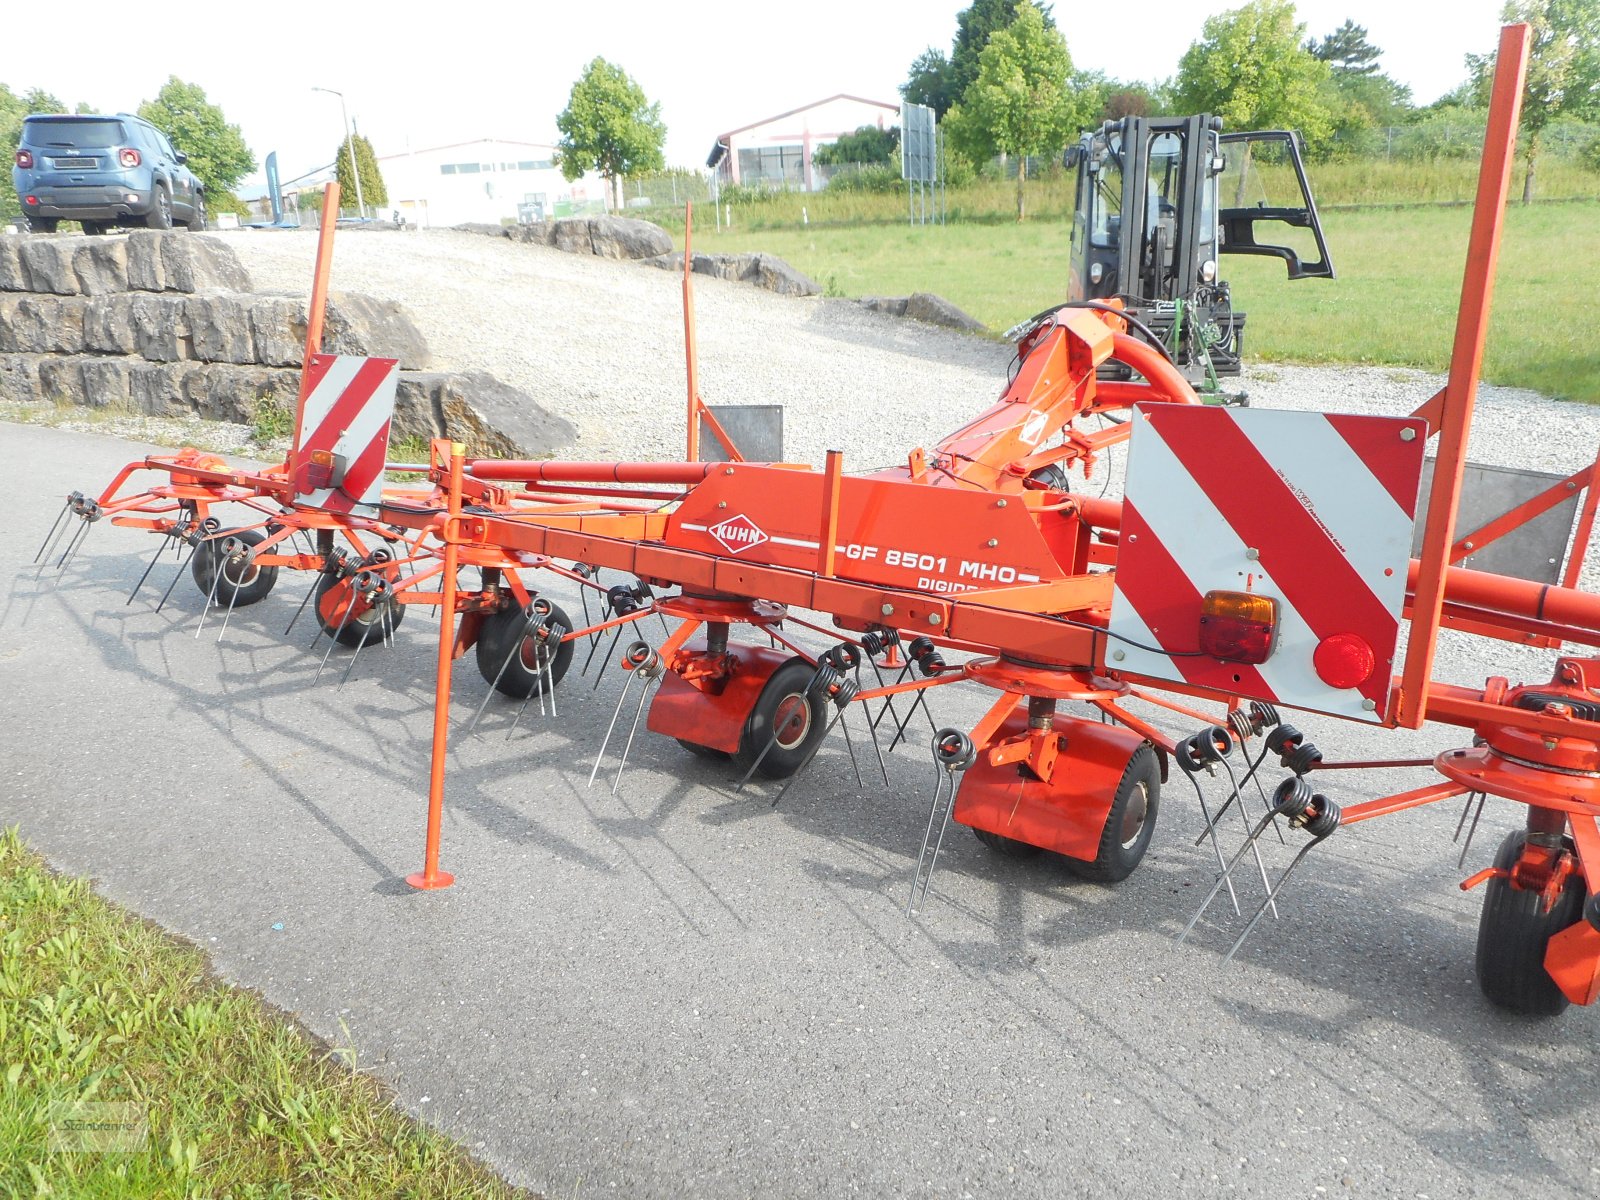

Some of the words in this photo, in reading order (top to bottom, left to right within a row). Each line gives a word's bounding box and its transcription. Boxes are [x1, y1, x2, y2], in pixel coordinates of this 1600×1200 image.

[717, 524, 760, 543] KUHN
[1333, 538, 1346, 553] GmbH
[847, 543, 878, 561] GF
[885, 550, 947, 573] 8501
[959, 561, 1016, 583] MHO
